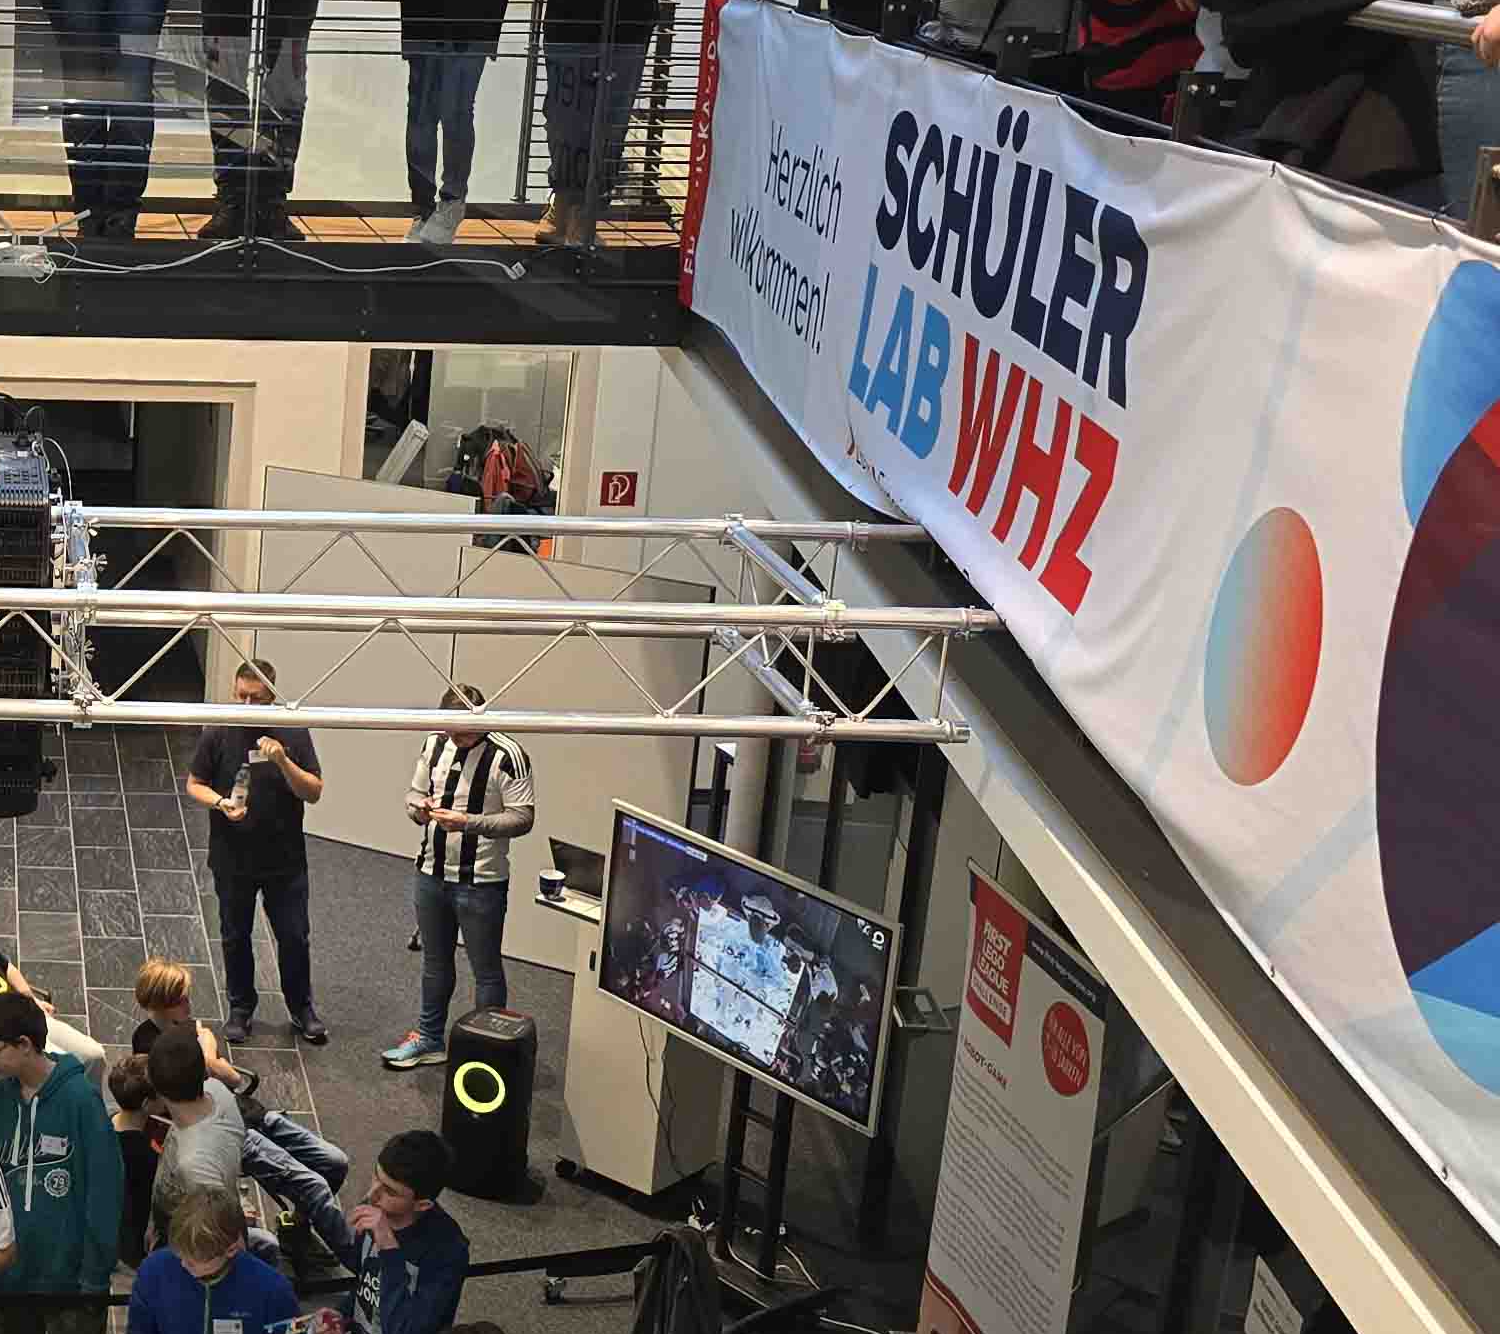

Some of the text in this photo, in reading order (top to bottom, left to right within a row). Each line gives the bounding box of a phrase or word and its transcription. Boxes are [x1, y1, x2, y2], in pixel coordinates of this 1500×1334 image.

[764, 119, 843, 244] Herzlich
[876, 105, 1149, 410] SCHÜLER
[847, 262, 1119, 616] LAB WHZ
